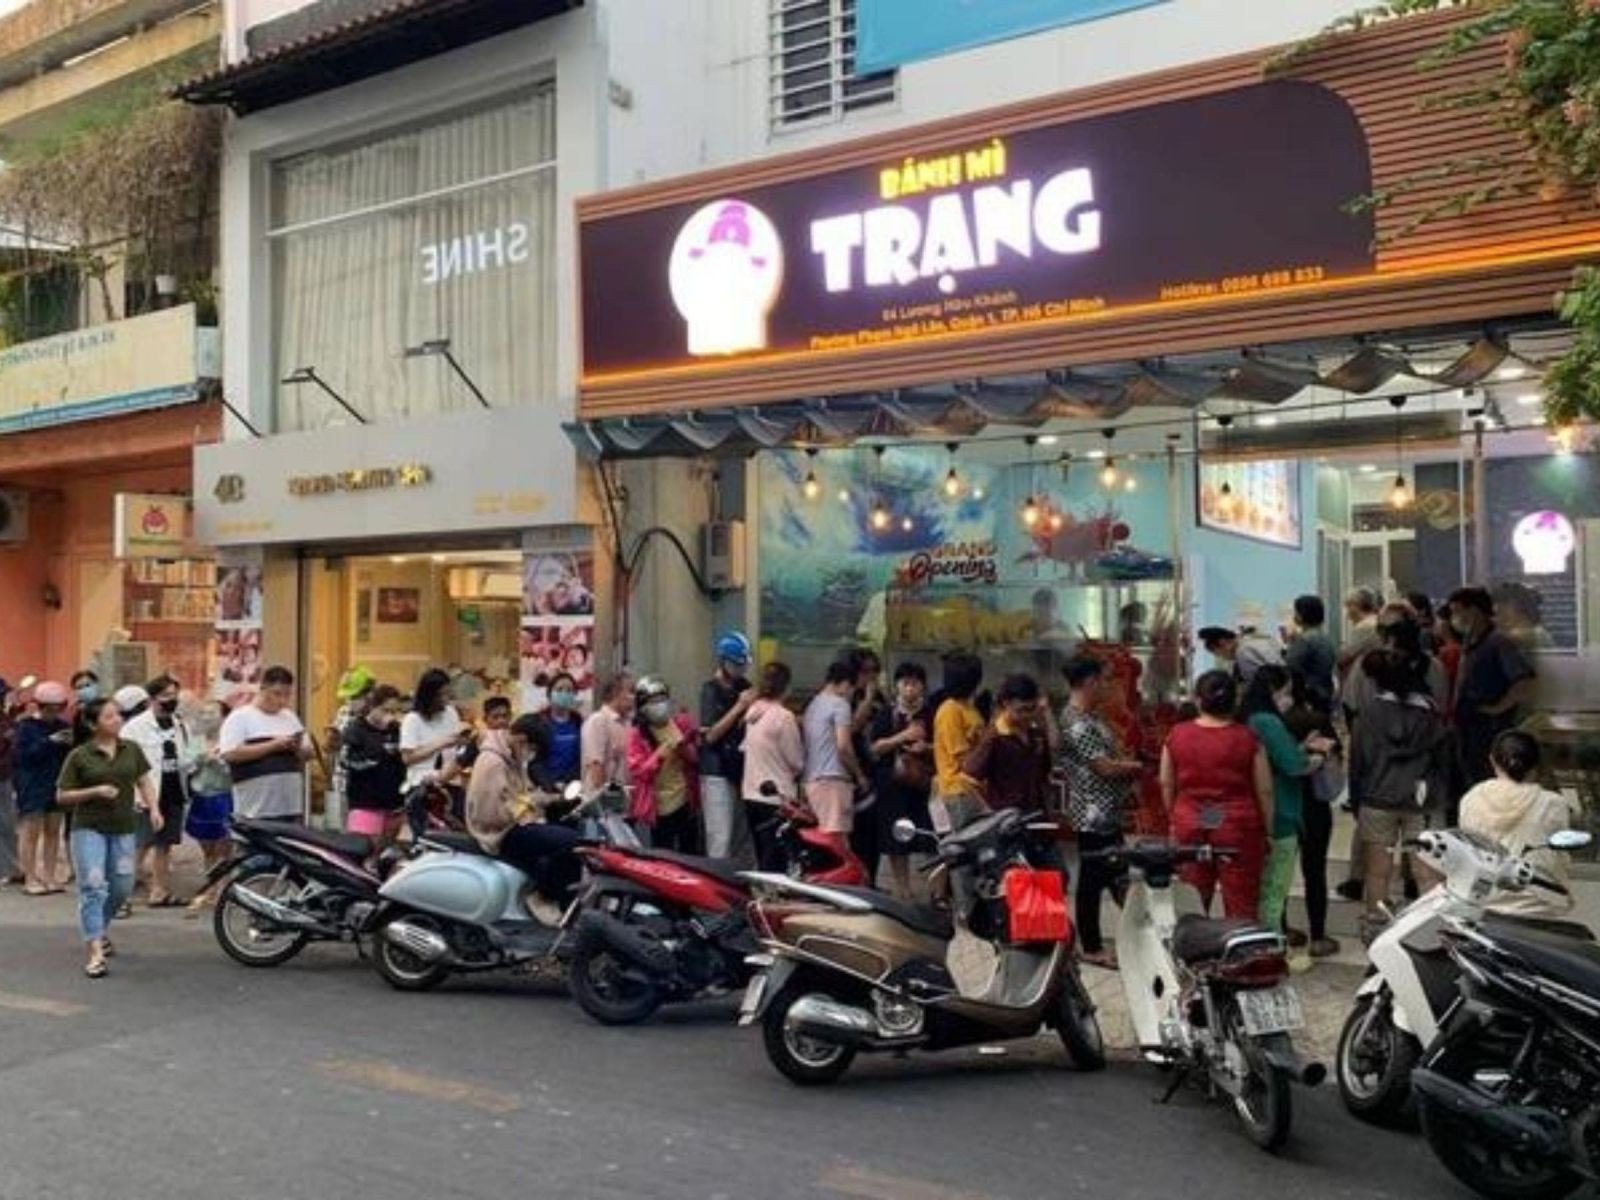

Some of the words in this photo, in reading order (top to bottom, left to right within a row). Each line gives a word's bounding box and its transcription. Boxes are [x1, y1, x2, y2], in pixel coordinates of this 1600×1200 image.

[879, 156, 961, 199] BÁNH
[965, 138, 1006, 181] MÌ
[810, 167, 1101, 293] TRẠNG
